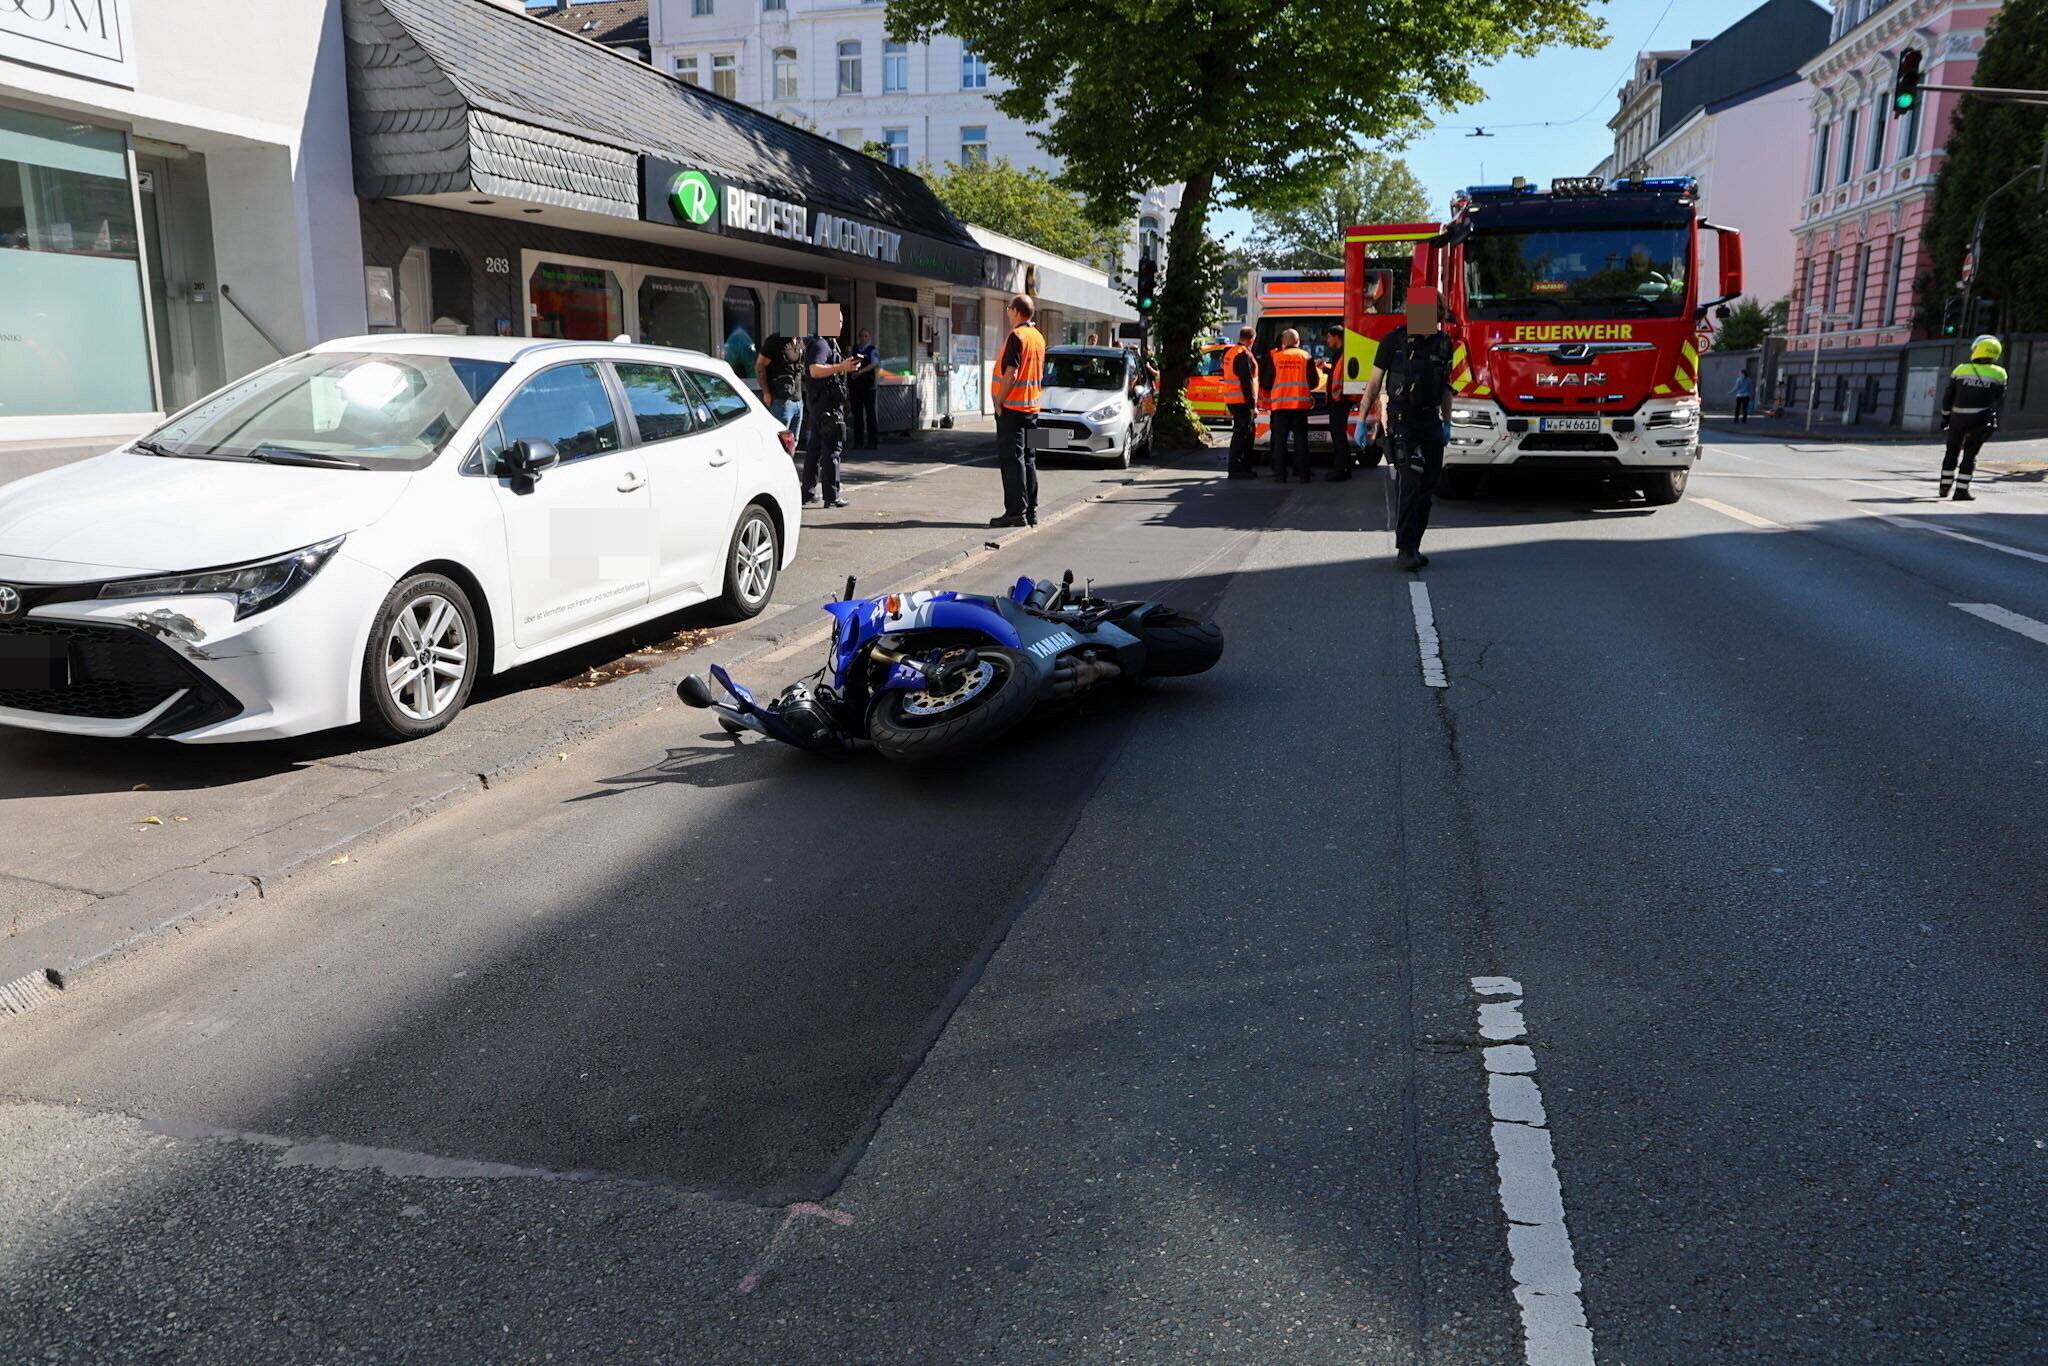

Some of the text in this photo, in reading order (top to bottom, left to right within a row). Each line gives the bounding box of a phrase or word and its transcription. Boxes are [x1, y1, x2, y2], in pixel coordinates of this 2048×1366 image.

[721, 185, 812, 244] RIEDESEL
[813, 212, 901, 264] AUGENOPTIK
[485, 257, 509, 273] 263
[1515, 324, 1633, 341] FEUERWEHR
[1536, 372, 1608, 387] MAN
[1574, 420, 1597, 430] 6616
[1028, 631, 1076, 659] YAMAHA
